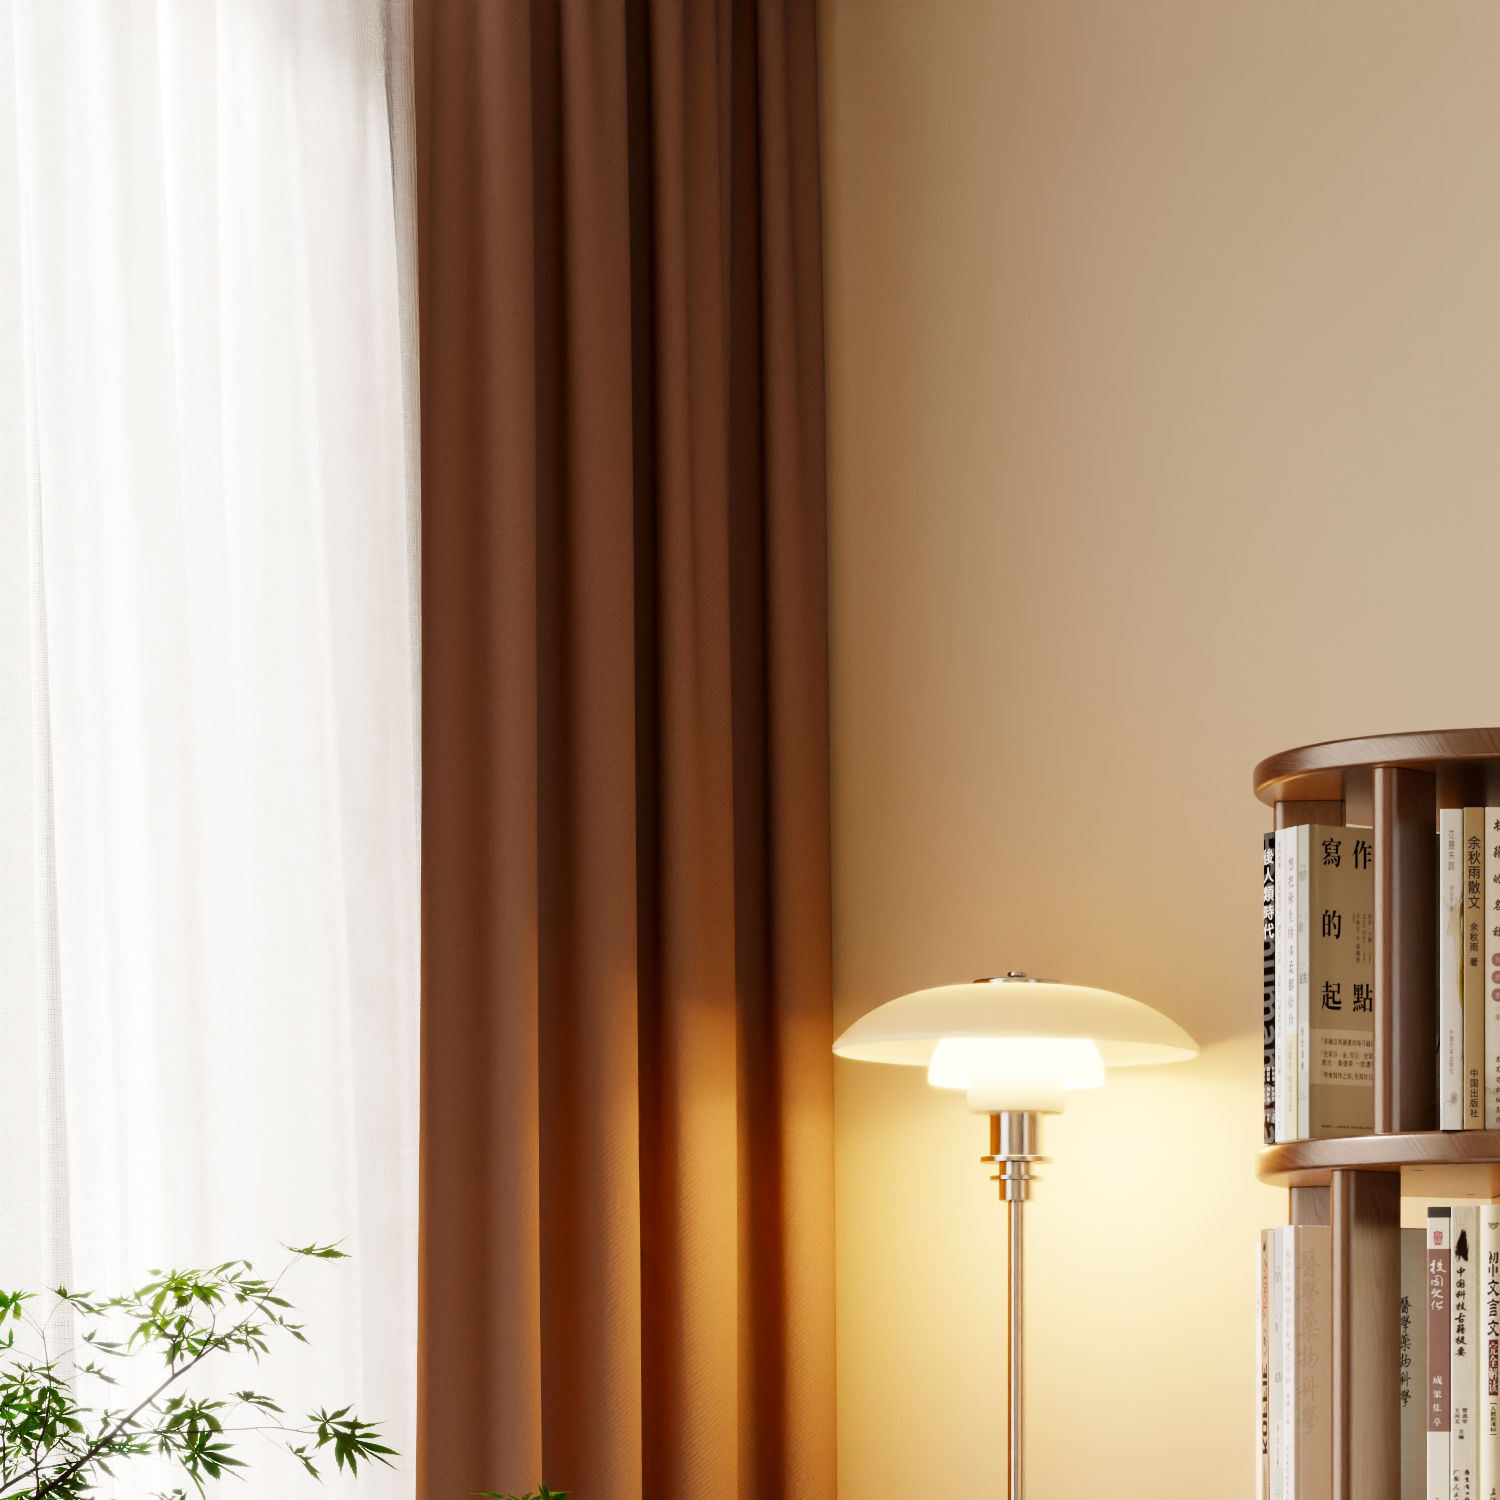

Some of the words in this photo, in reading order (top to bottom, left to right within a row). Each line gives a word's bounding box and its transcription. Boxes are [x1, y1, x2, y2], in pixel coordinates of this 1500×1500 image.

[1467, 835, 1481, 910] 余秋雨散文
[1322, 909, 1341, 939] 的
[1469, 922, 1479, 953] 余秋雨
[1321, 981, 1373, 1012] 起點
[1469, 1068, 1479, 1118] 中国出版社
[1429, 1259, 1447, 1311] 校园文化
[1487, 1251, 1500, 1337] 初中文言文
[1454, 1266, 1467, 1357] 中国科技古籍提要
